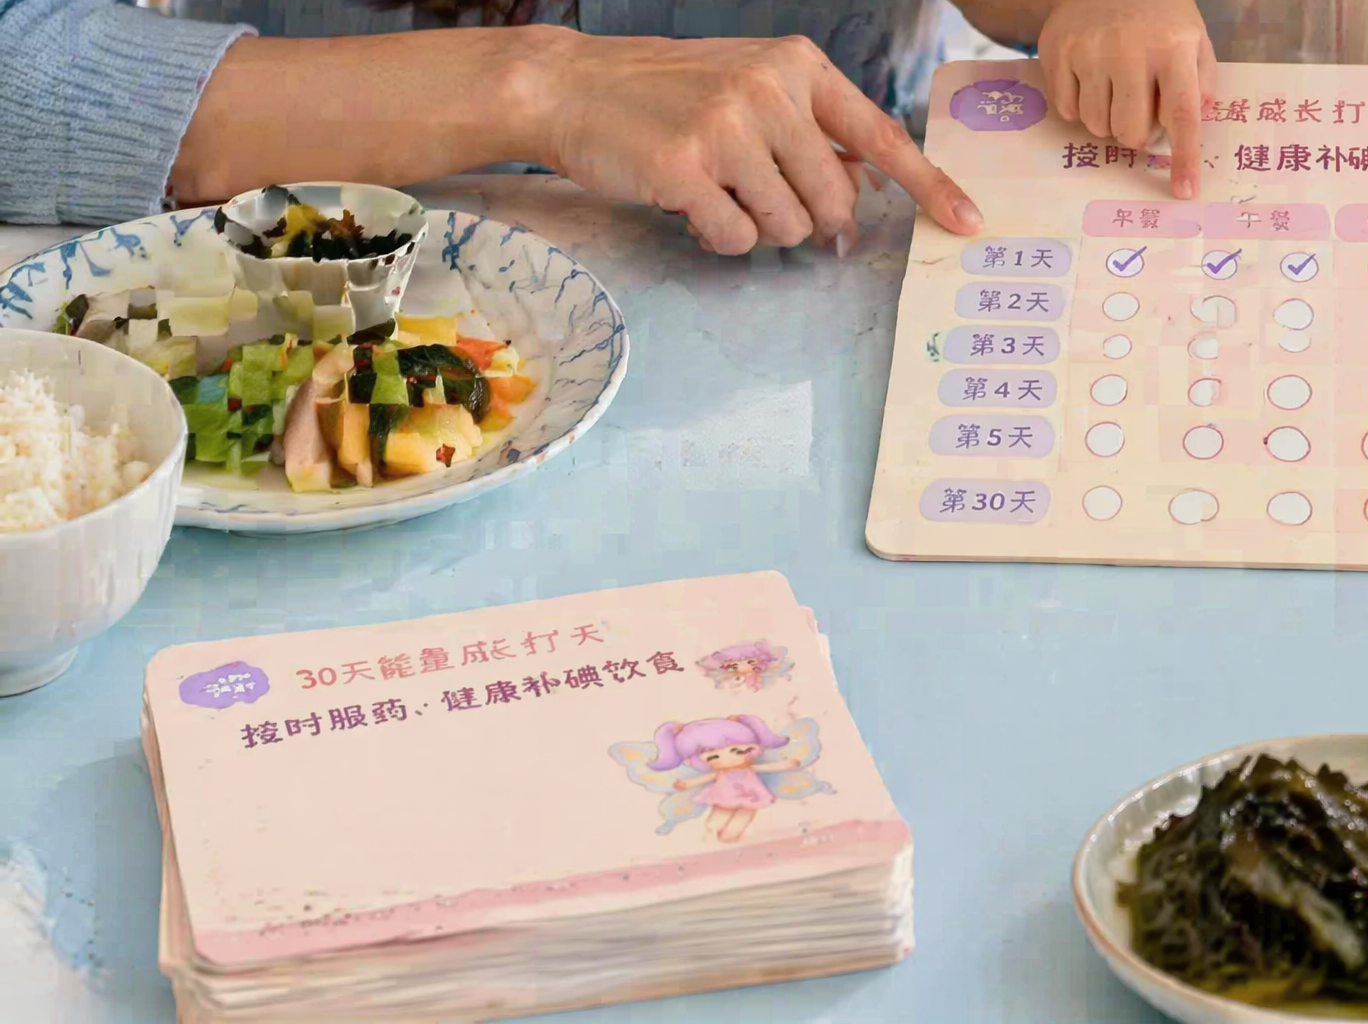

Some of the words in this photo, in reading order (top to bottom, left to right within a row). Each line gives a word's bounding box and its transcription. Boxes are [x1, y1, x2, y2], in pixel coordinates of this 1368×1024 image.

[982, 245, 1054, 269] 第1天
[977, 288, 1050, 313] 第2天
[970, 333, 1045, 357] 第3天
[962, 376, 1043, 401] 第4天
[955, 423, 1034, 449] 第5天
[939, 487, 1037, 514] 第30天
